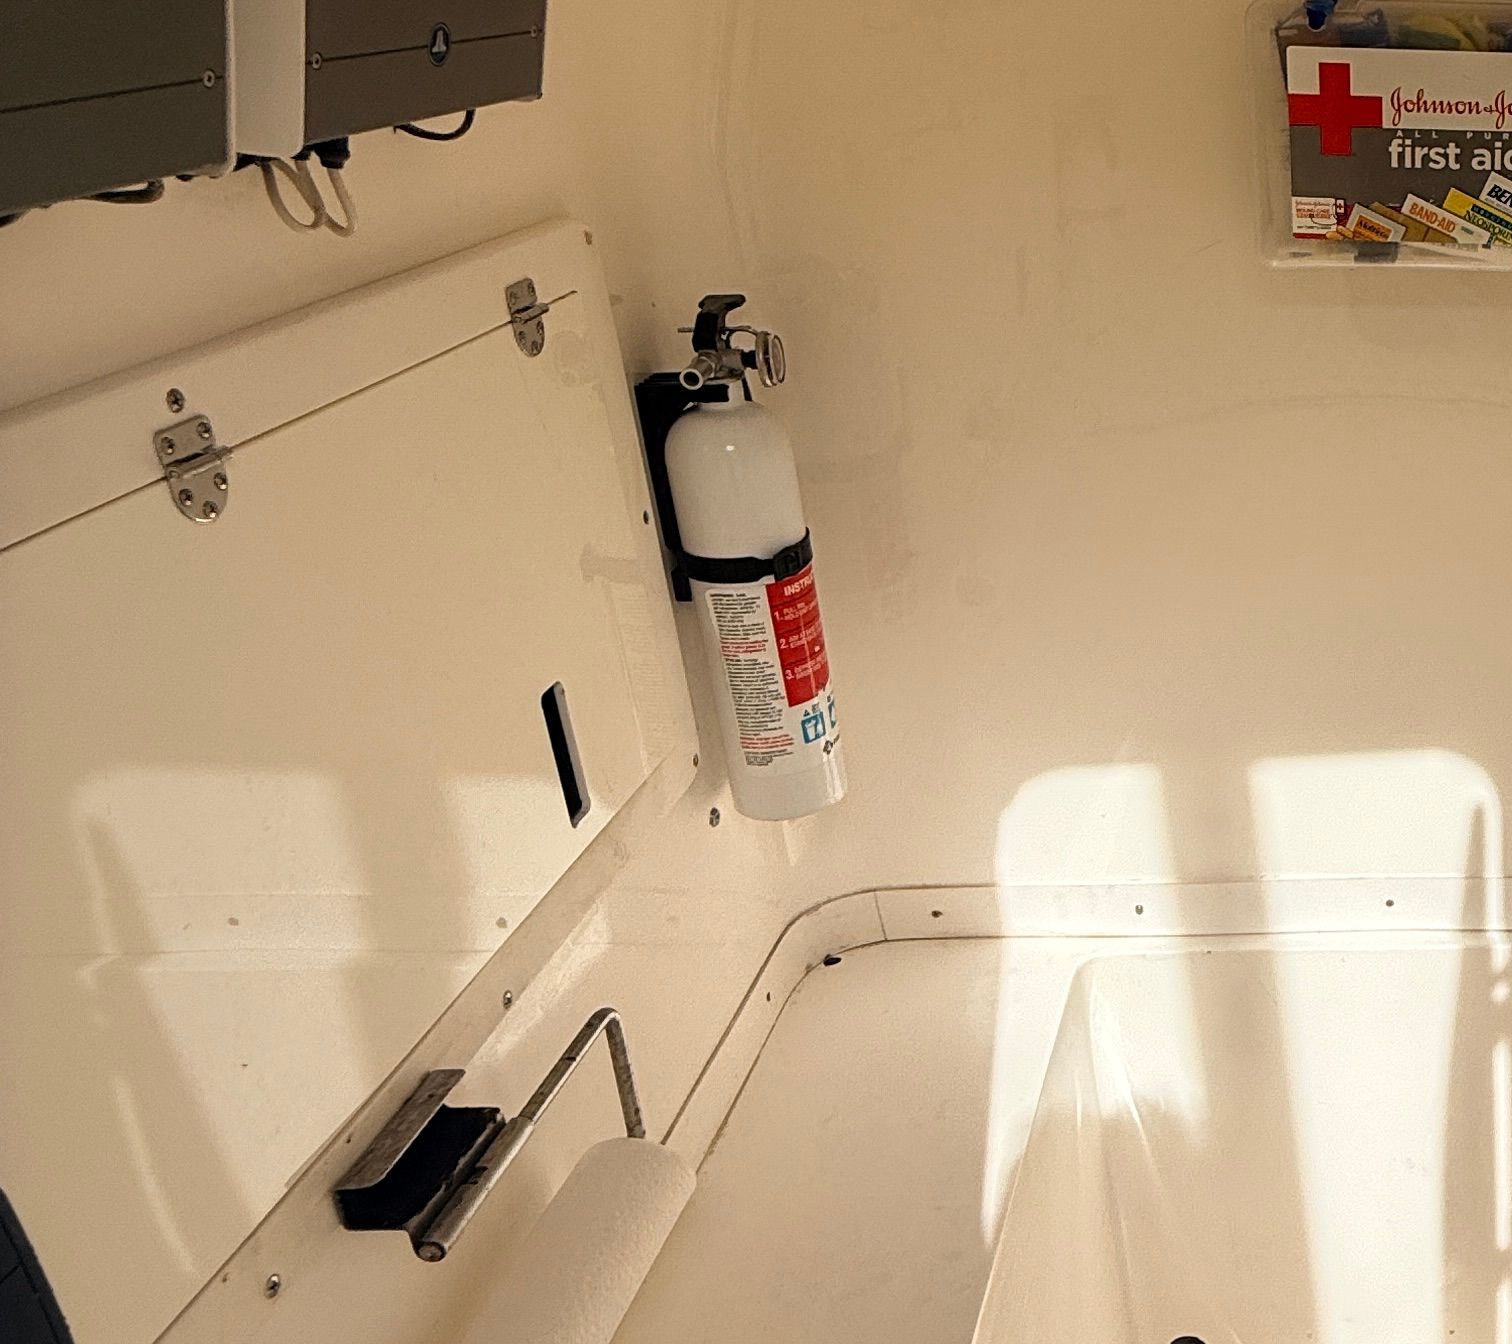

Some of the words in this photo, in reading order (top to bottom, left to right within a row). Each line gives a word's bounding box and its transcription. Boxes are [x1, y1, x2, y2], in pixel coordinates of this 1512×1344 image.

[1395, 129, 1440, 139] ALL
[1388, 138, 1461, 170] first
[1408, 202, 1456, 233] BAND-AID
